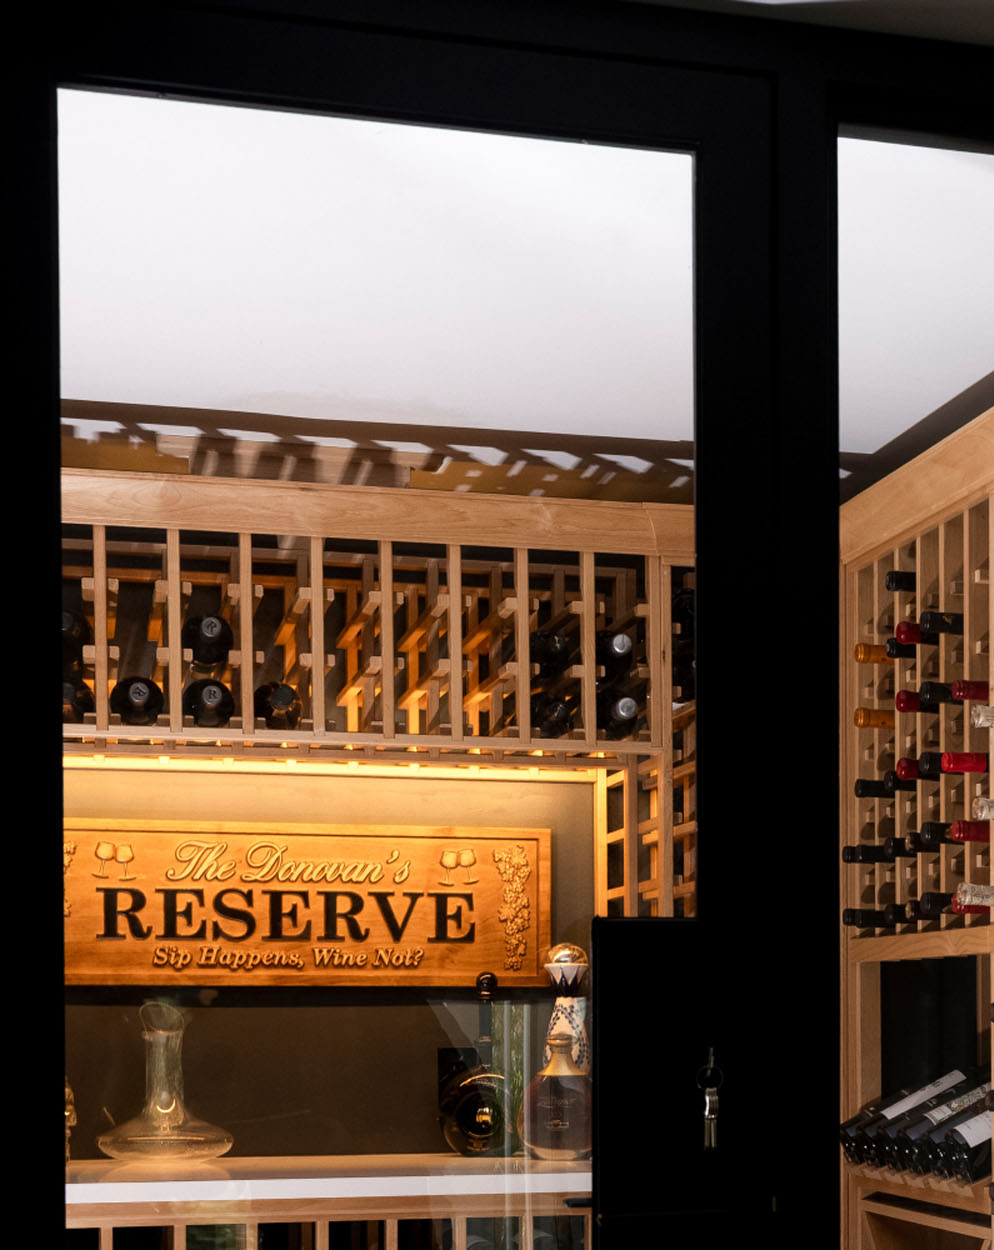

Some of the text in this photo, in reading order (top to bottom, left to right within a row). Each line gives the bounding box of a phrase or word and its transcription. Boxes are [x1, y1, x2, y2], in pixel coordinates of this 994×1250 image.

[167, 839, 412, 885] The Donovan's
[96, 887, 476, 944] RESERVE
[153, 946, 424, 970] Sip Happens, Wine Not?
